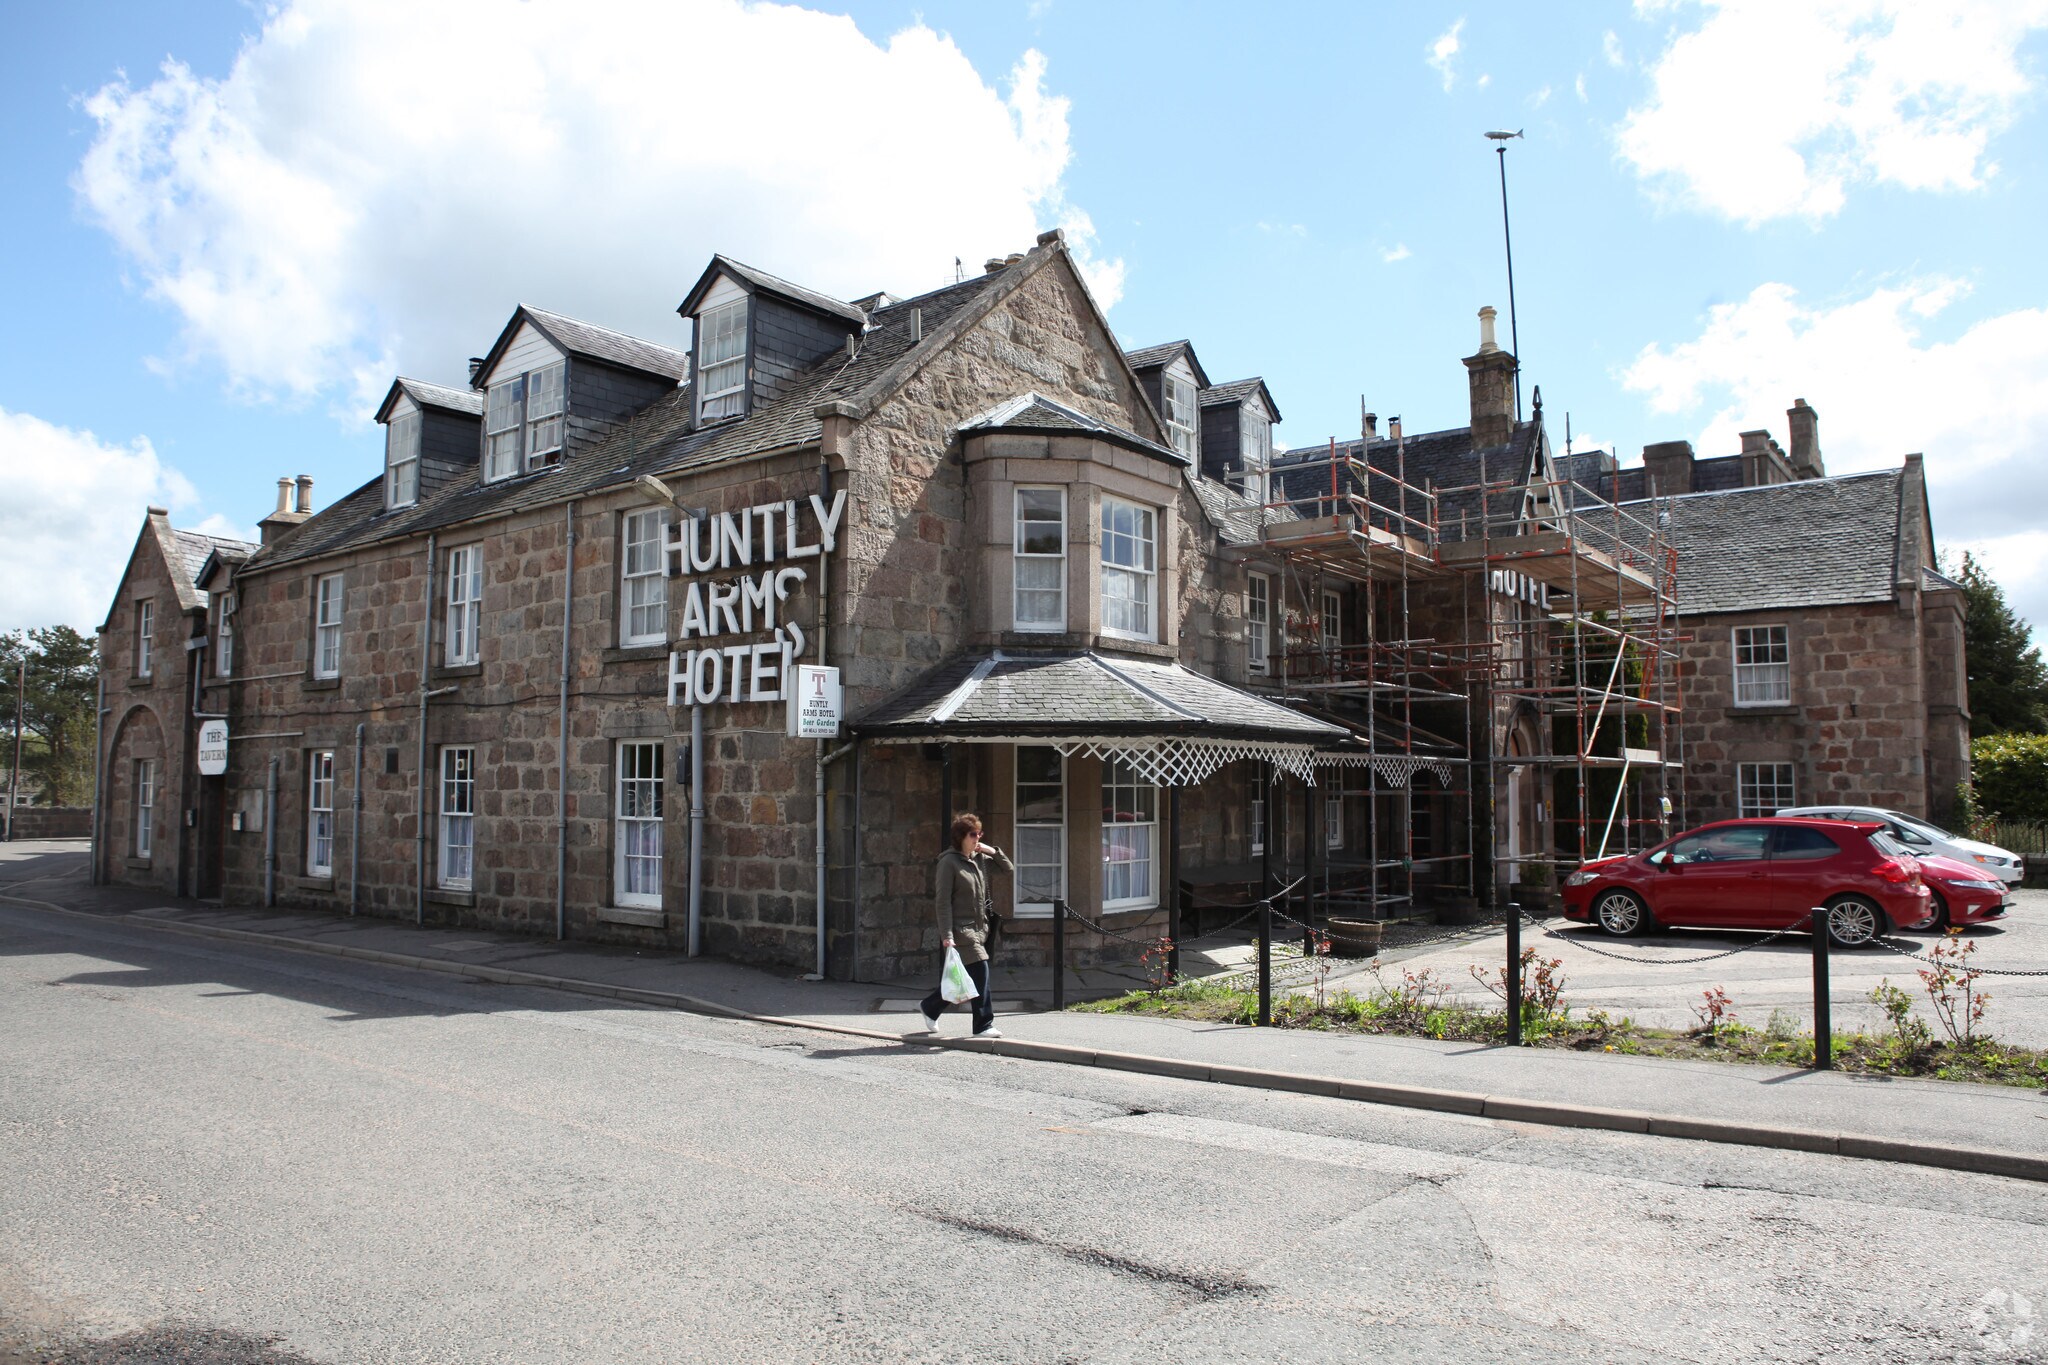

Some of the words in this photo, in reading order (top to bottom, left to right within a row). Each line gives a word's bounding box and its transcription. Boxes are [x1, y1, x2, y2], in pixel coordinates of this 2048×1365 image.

[661, 488, 848, 577] HUNTLY
[809, 700, 828, 708] HUNTLY
[819, 710, 835, 718] HOTEL
[206, 731, 221, 742] THE
[200, 750, 226, 760] TAVERN
